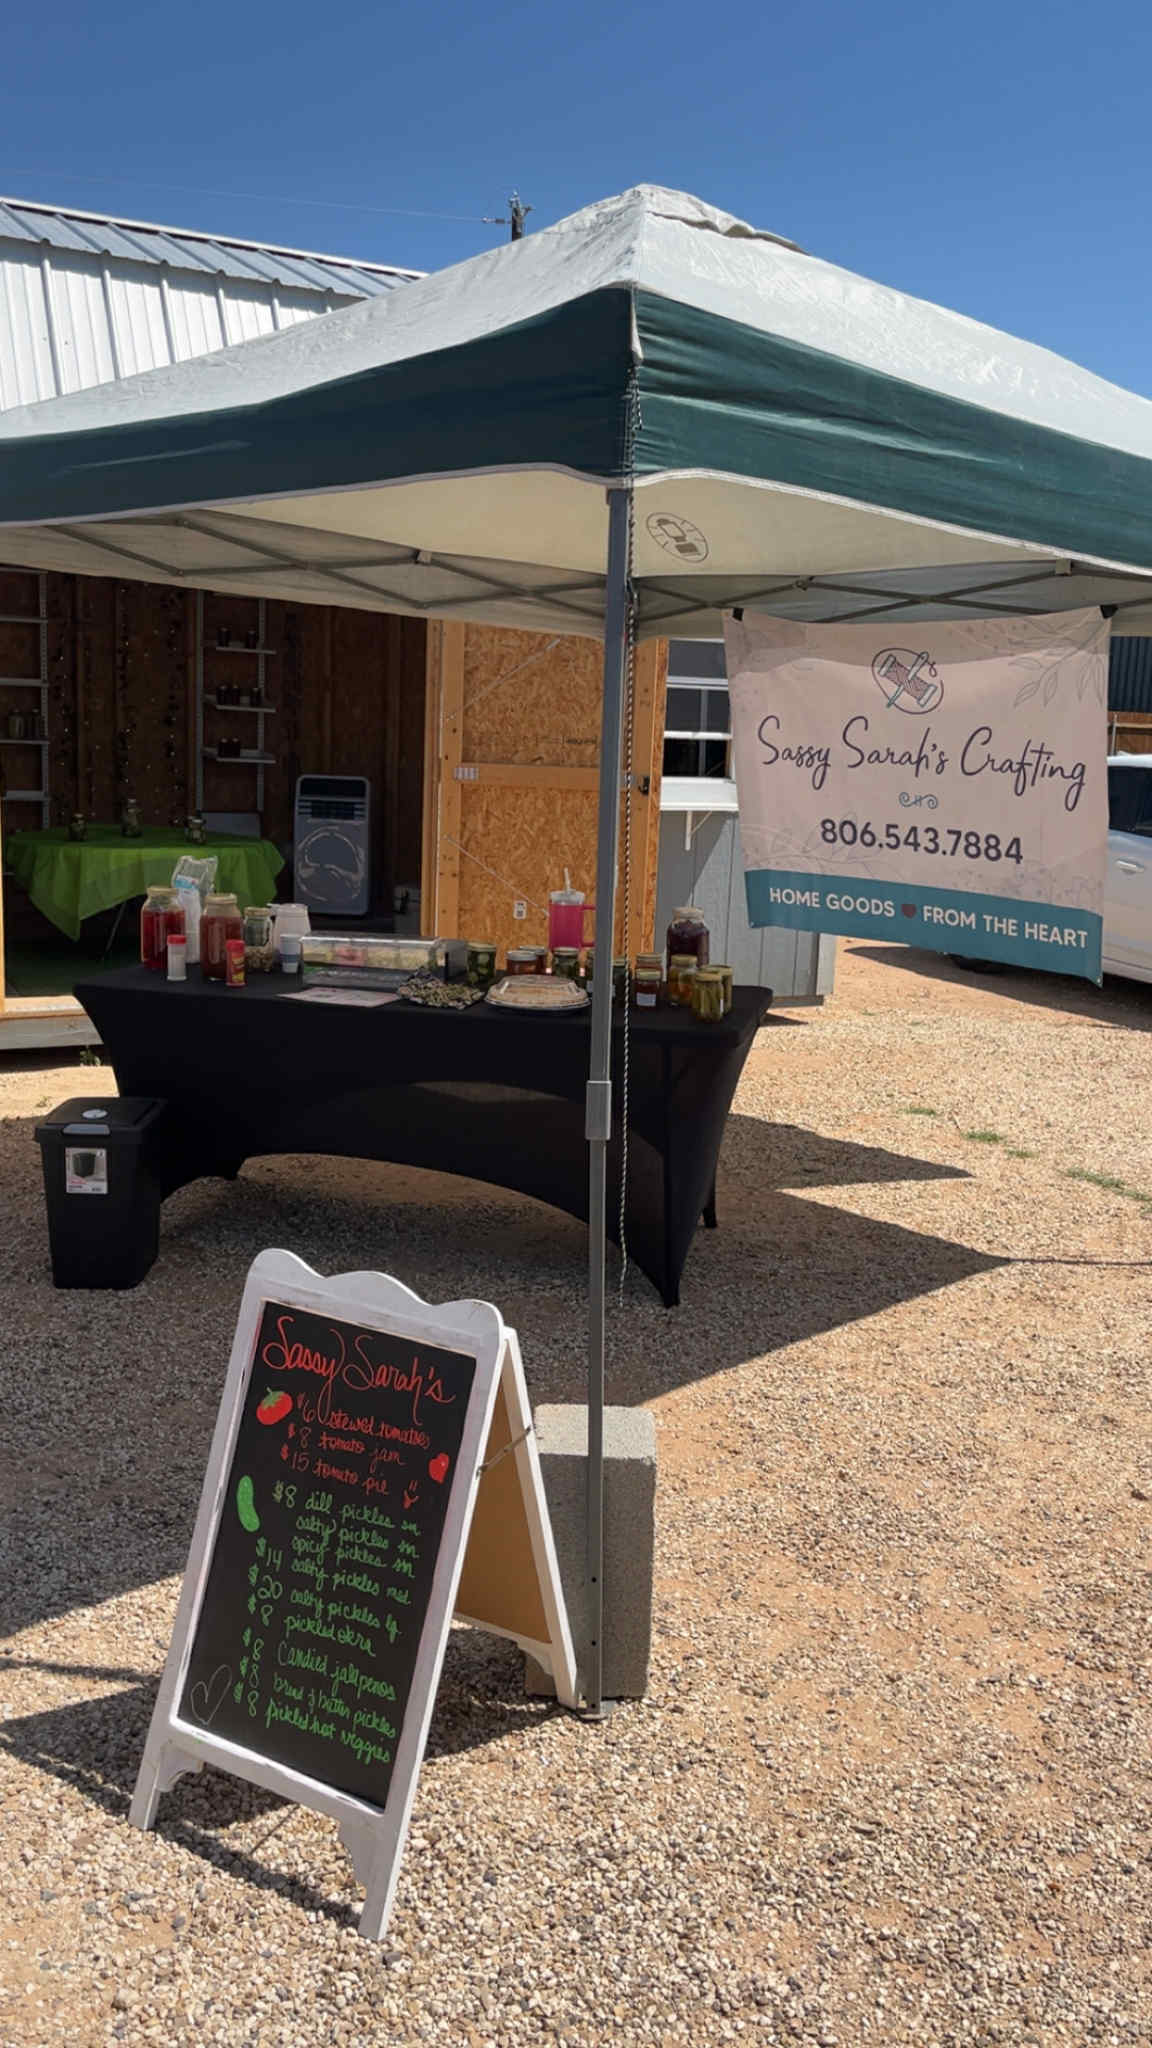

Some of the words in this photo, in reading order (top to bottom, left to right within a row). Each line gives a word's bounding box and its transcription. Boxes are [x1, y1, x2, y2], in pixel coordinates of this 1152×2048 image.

[757, 715, 832, 790] Sassy
[842, 716, 949, 778] Sarah's
[960, 726, 1086, 812] Crafting
[820, 818, 1023, 864] 806.543.7884
[769, 888, 820, 909] HOME
[826, 894, 895, 918] GOODS
[922, 905, 977, 930] FROM
[983, 915, 1018, 937] THE
[1024, 921, 1088, 948] HEART
[262, 1315, 346, 1426] Sassy
[342, 1334, 456, 1426] Sarah's
[326, 1408, 378, 1436] stewed
[280, 1444, 310, 1472] $15
[312, 1457, 359, 1485] tomato
[361, 1472, 390, 1496] pie
[318, 1431, 366, 1454] tomato
[369, 1447, 408, 1474] jam
[272, 1479, 297, 1509] $8
[304, 1491, 334, 1514] dill
[339, 1503, 396, 1529] pickles
[334, 1545, 388, 1567] pickles
[338, 1525, 390, 1550] pickles
[255, 1536, 283, 1572] $14
[332, 1569, 380, 1596] pickles
[247, 1563, 283, 1600] $20
[327, 1600, 381, 1629] pickles
[283, 1614, 336, 1639] pickled
[337, 1625, 377, 1657] okra
[272, 1671, 304, 1700] bread
[318, 1689, 350, 1719] butter
[352, 1707, 396, 1738] pickles
